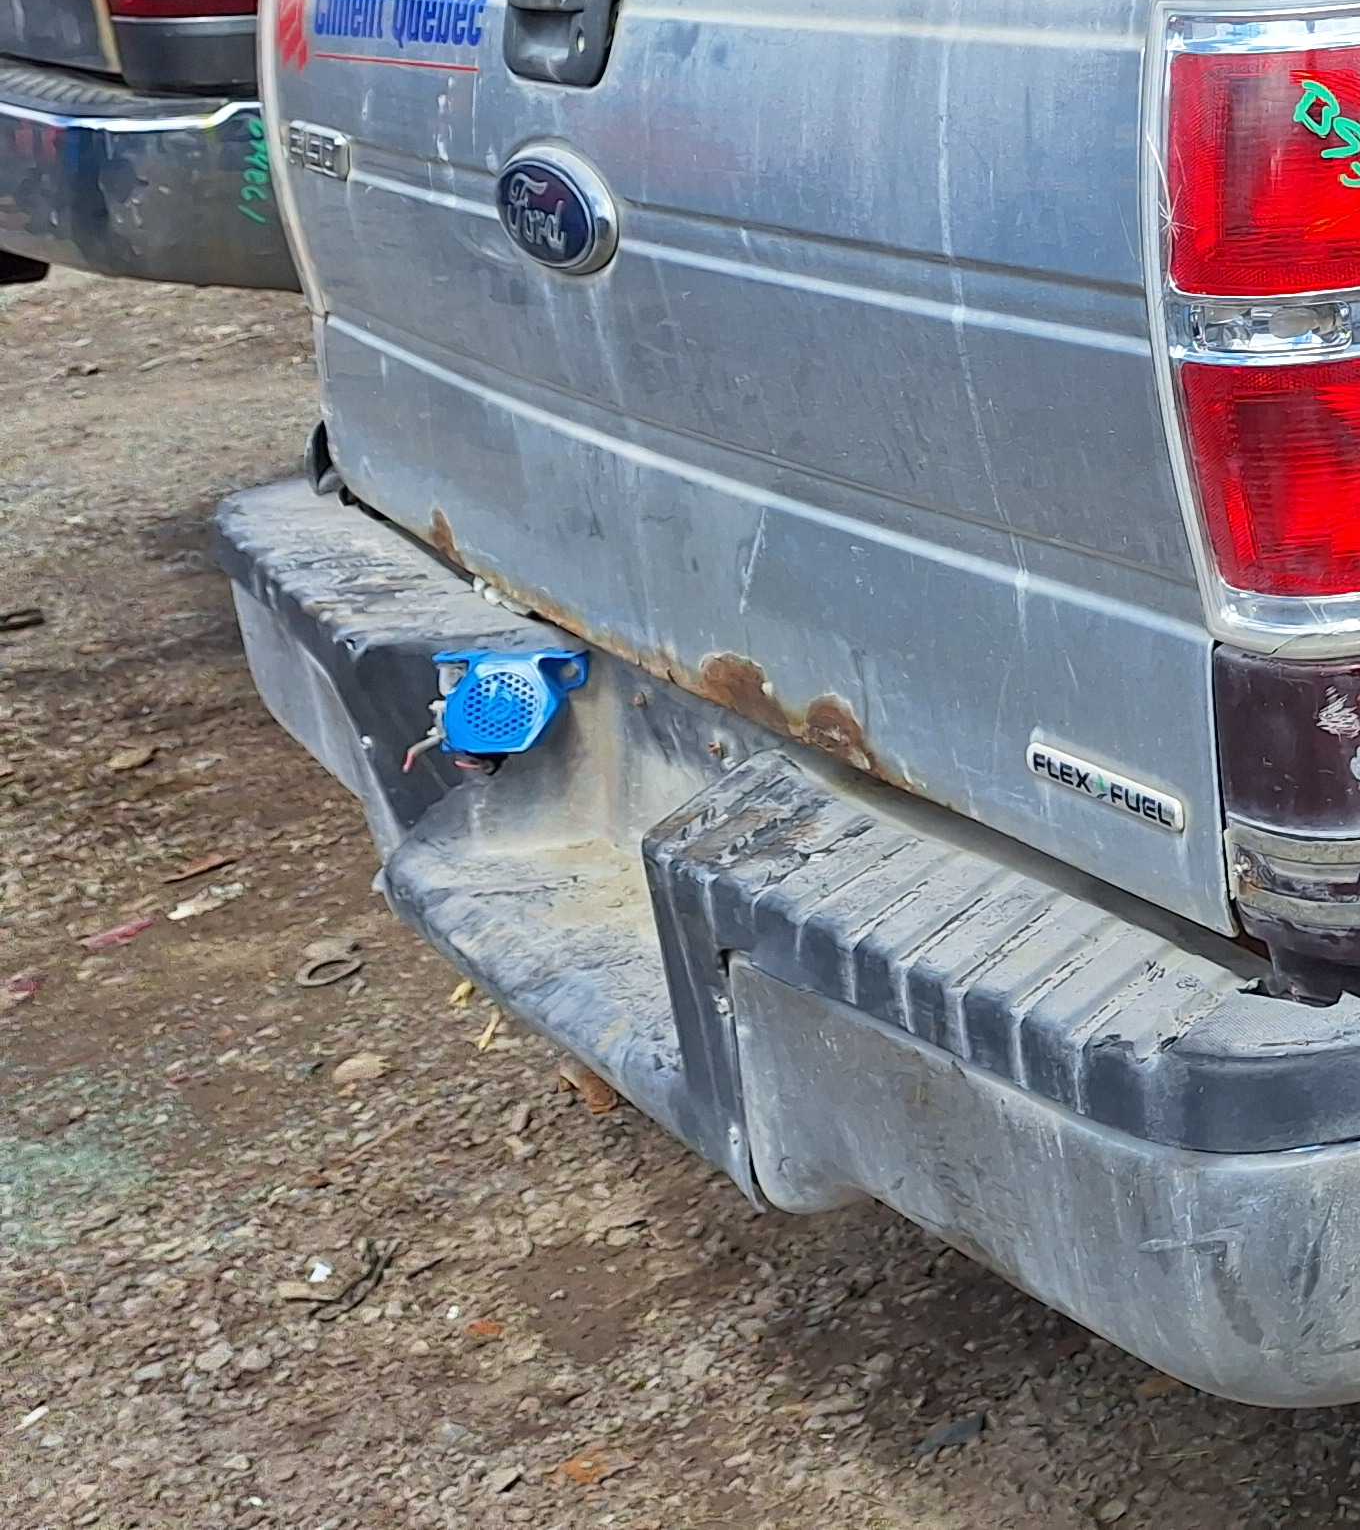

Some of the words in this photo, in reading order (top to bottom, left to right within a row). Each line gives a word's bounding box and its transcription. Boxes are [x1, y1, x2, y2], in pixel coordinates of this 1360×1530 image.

[507, 171, 568, 256] Ford
[1032, 751, 1093, 794] FLEX
[1109, 781, 1173, 828] FUEL
